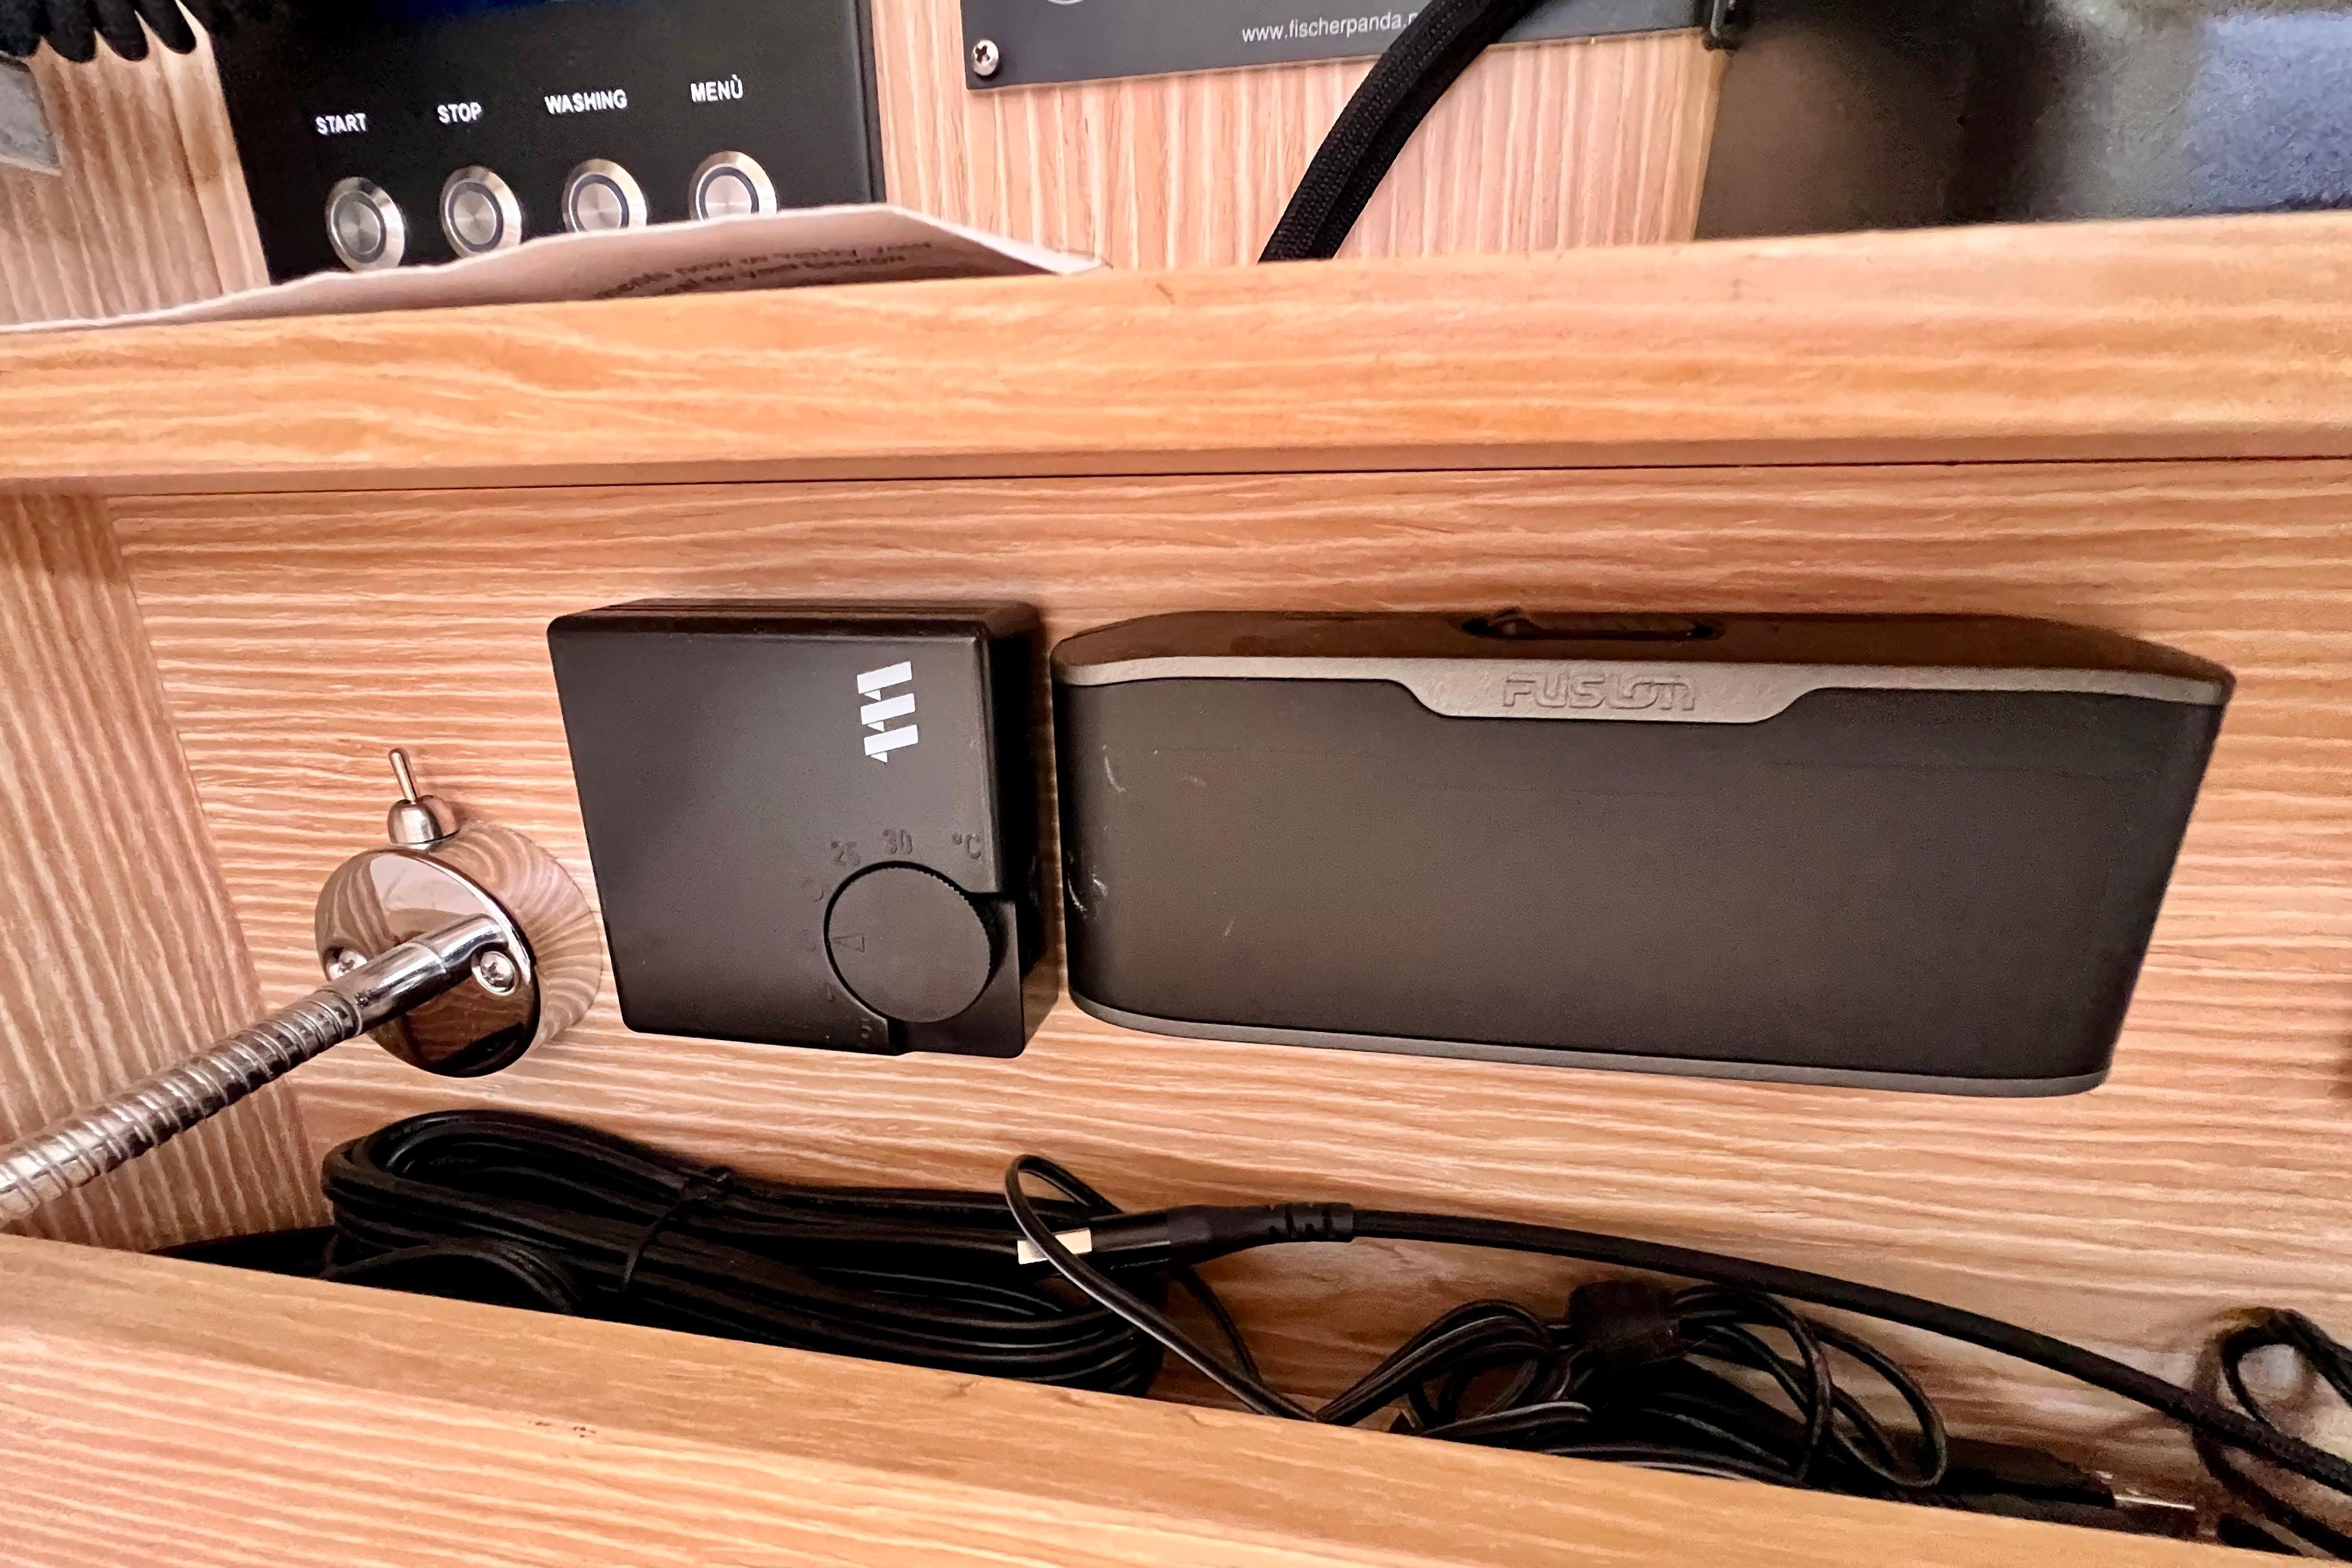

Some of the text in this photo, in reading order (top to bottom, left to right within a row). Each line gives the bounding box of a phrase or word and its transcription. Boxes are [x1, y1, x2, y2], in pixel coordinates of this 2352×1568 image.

[690, 74, 744, 103] MENÙ
[437, 102, 482, 124] STOP
[544, 89, 627, 114] WASHING
[316, 113, 367, 135] START
[883, 829, 912, 855] 30
